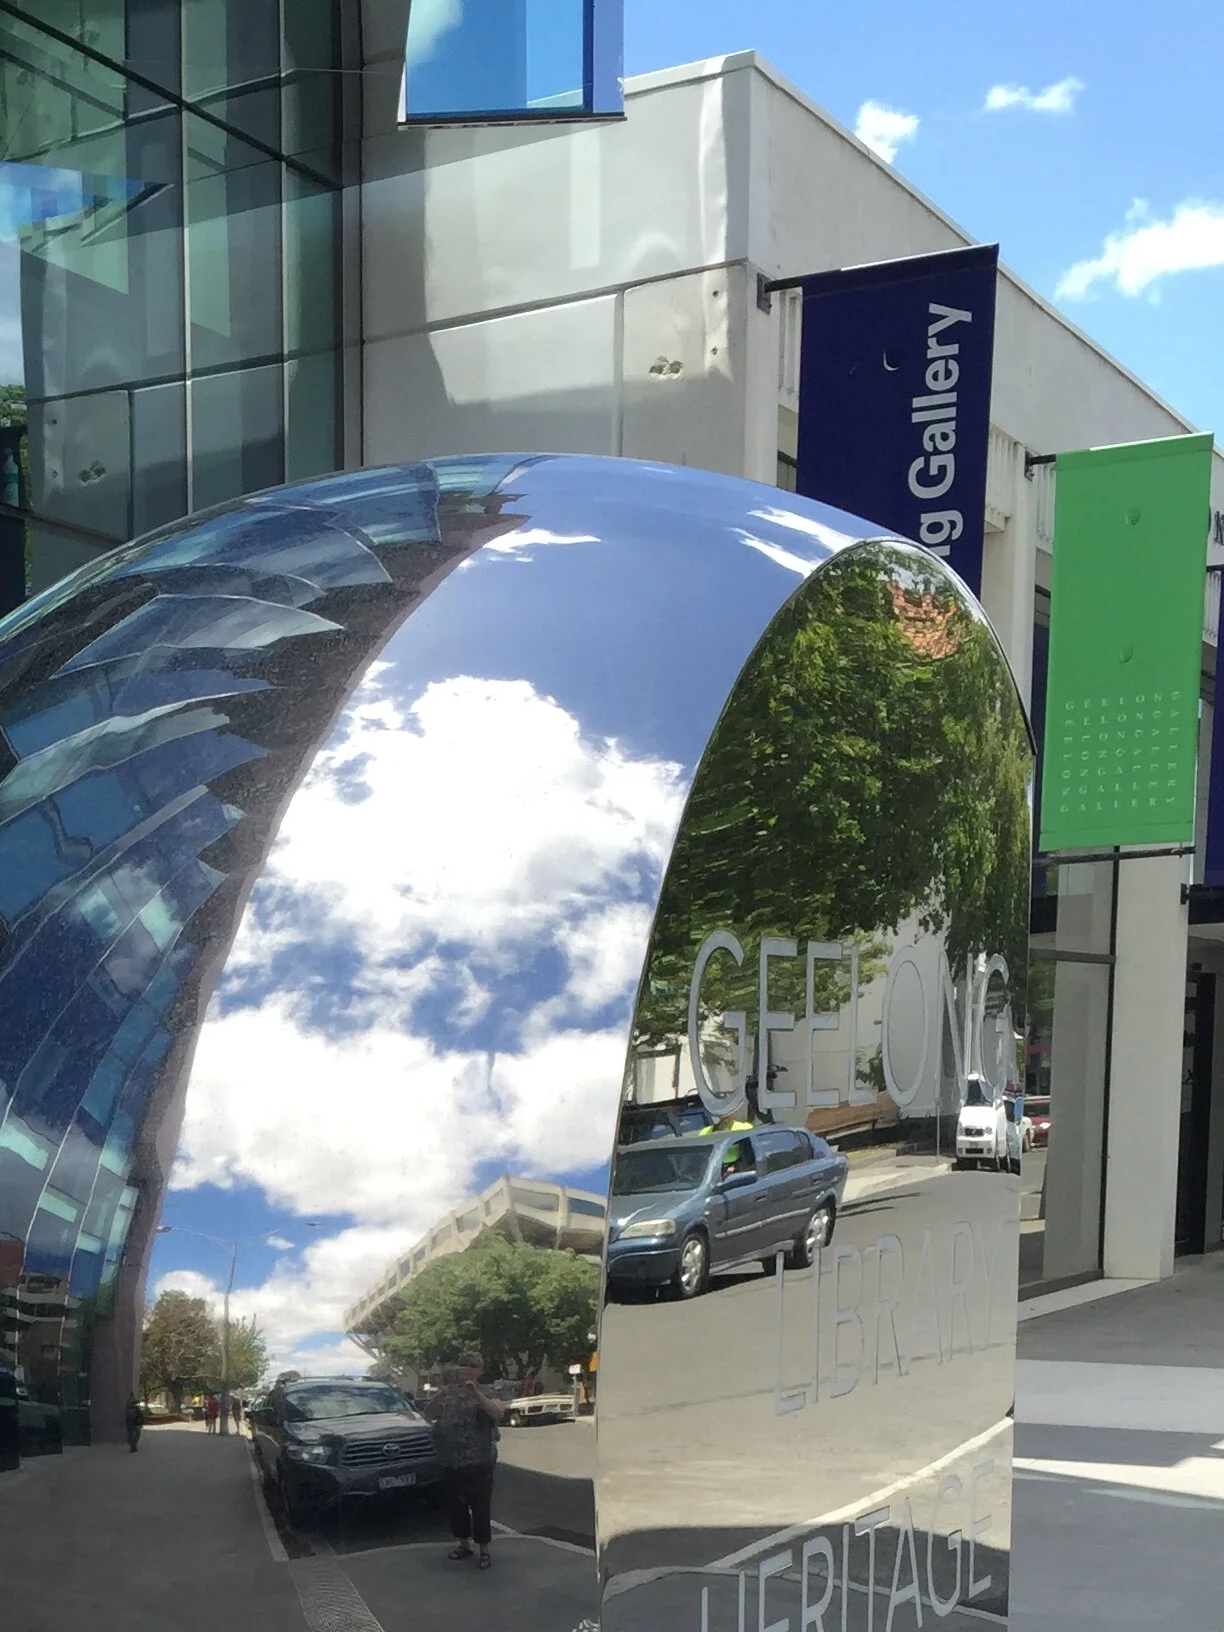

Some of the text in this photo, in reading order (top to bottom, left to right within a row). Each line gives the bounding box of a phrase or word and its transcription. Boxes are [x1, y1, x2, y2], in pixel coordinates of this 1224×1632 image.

[907, 303, 973, 500] Gallery
[688, 929, 1010, 1117] GEELONG
[776, 1218, 1005, 1418] LIBRARY
